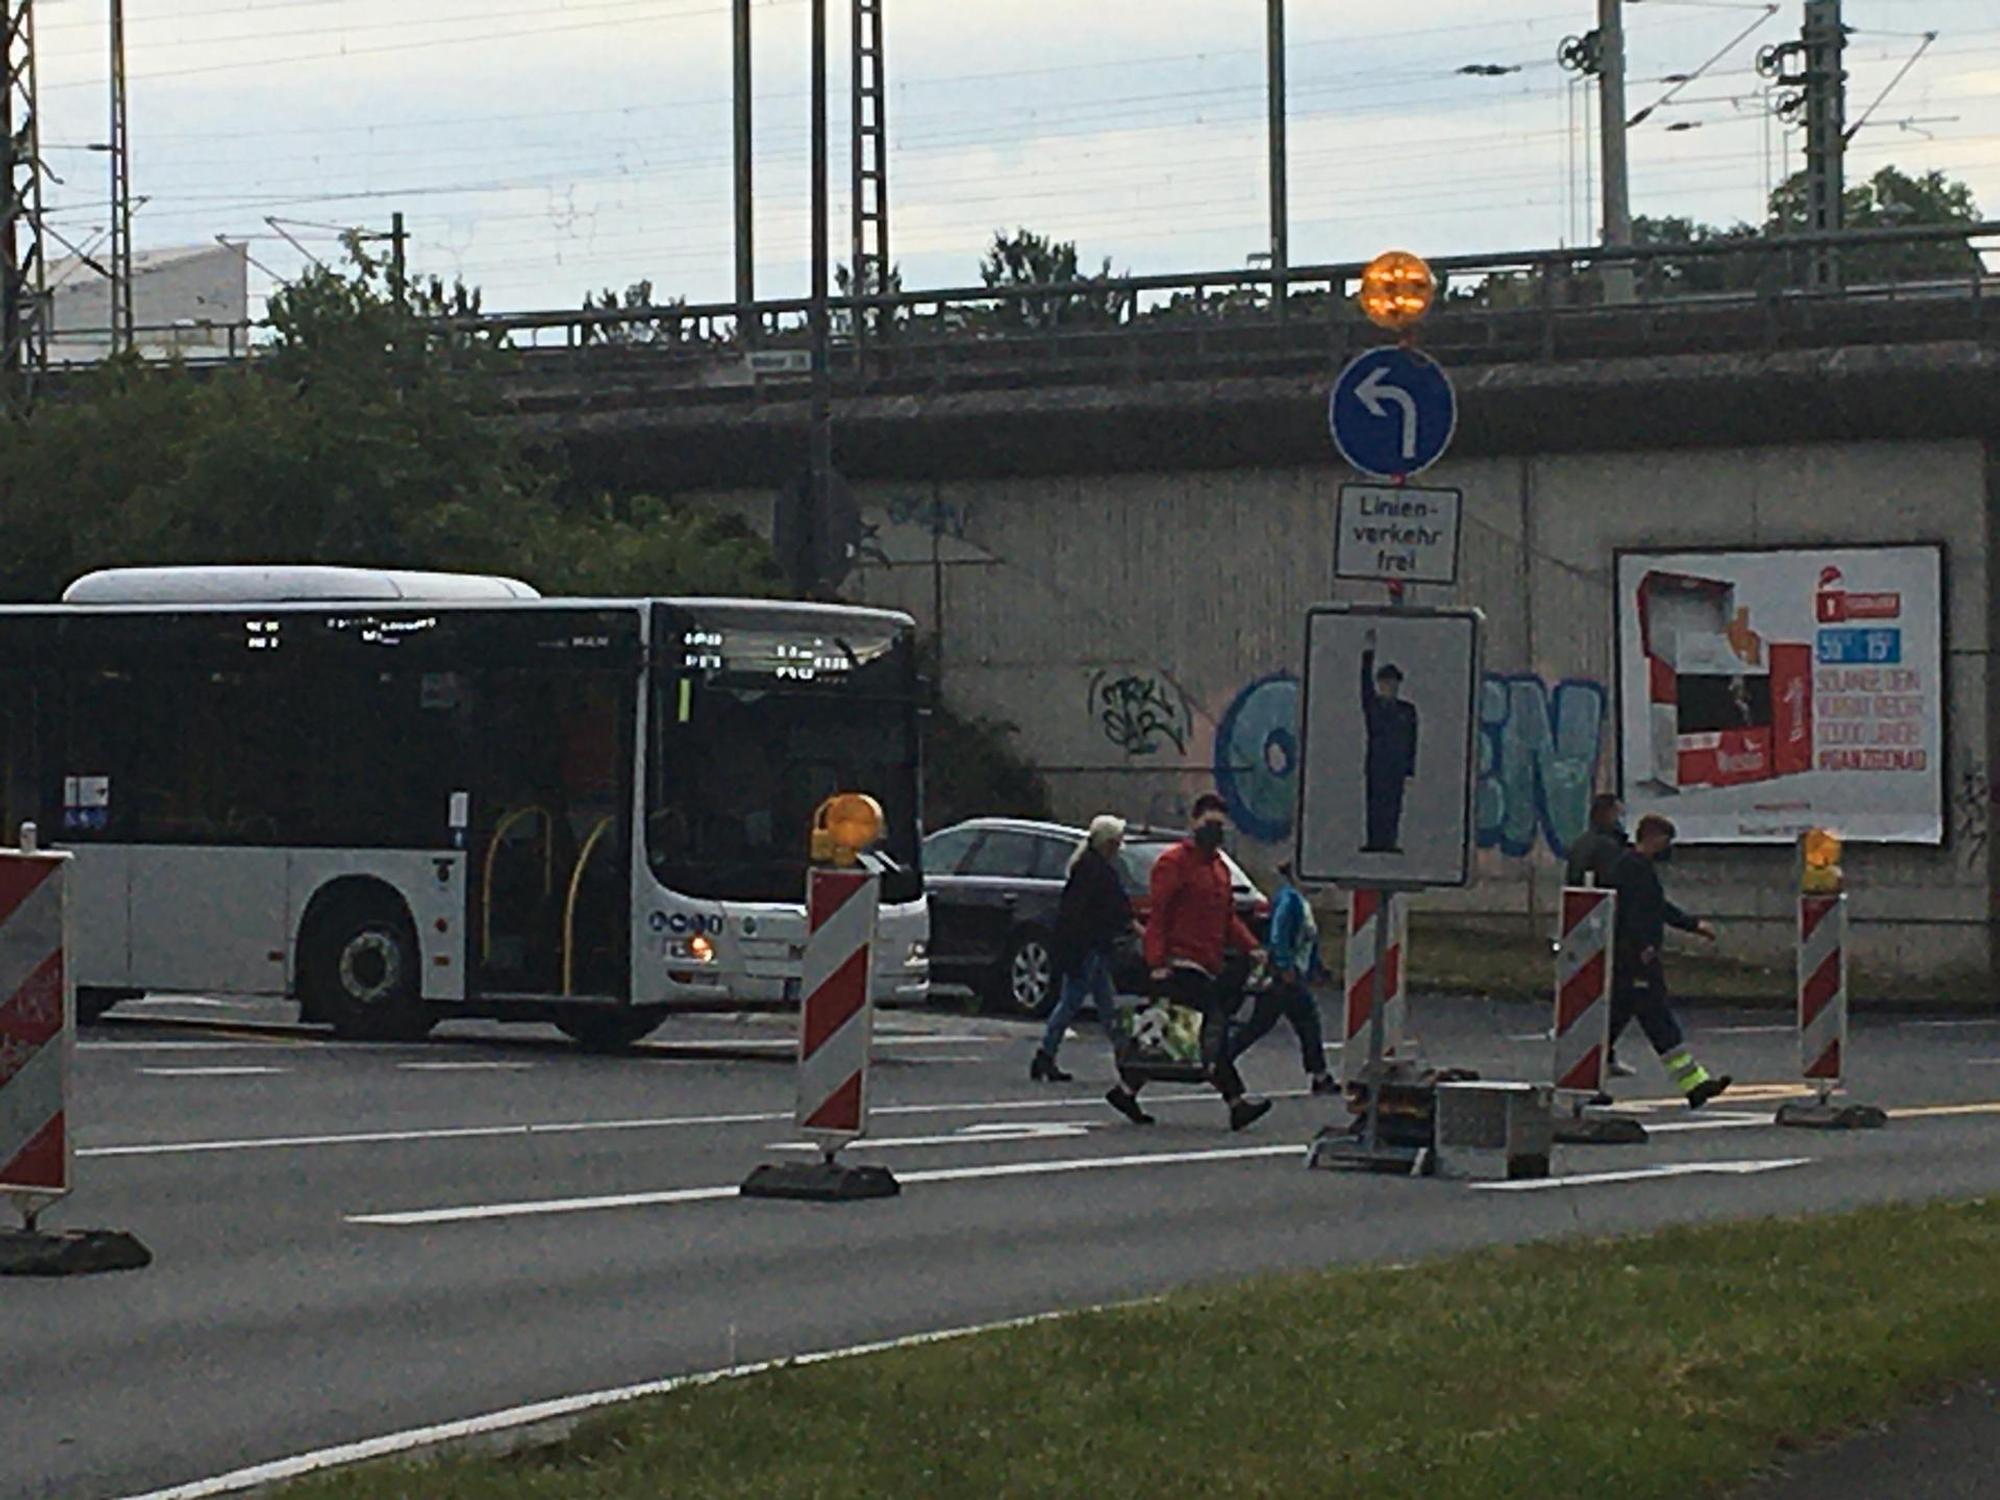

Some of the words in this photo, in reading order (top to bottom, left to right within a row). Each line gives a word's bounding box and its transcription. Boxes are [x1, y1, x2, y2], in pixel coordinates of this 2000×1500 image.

[1360, 496, 1438, 517] Linien-
[1353, 523, 1442, 545] verkehr
[1377, 550, 1416, 571] frei
